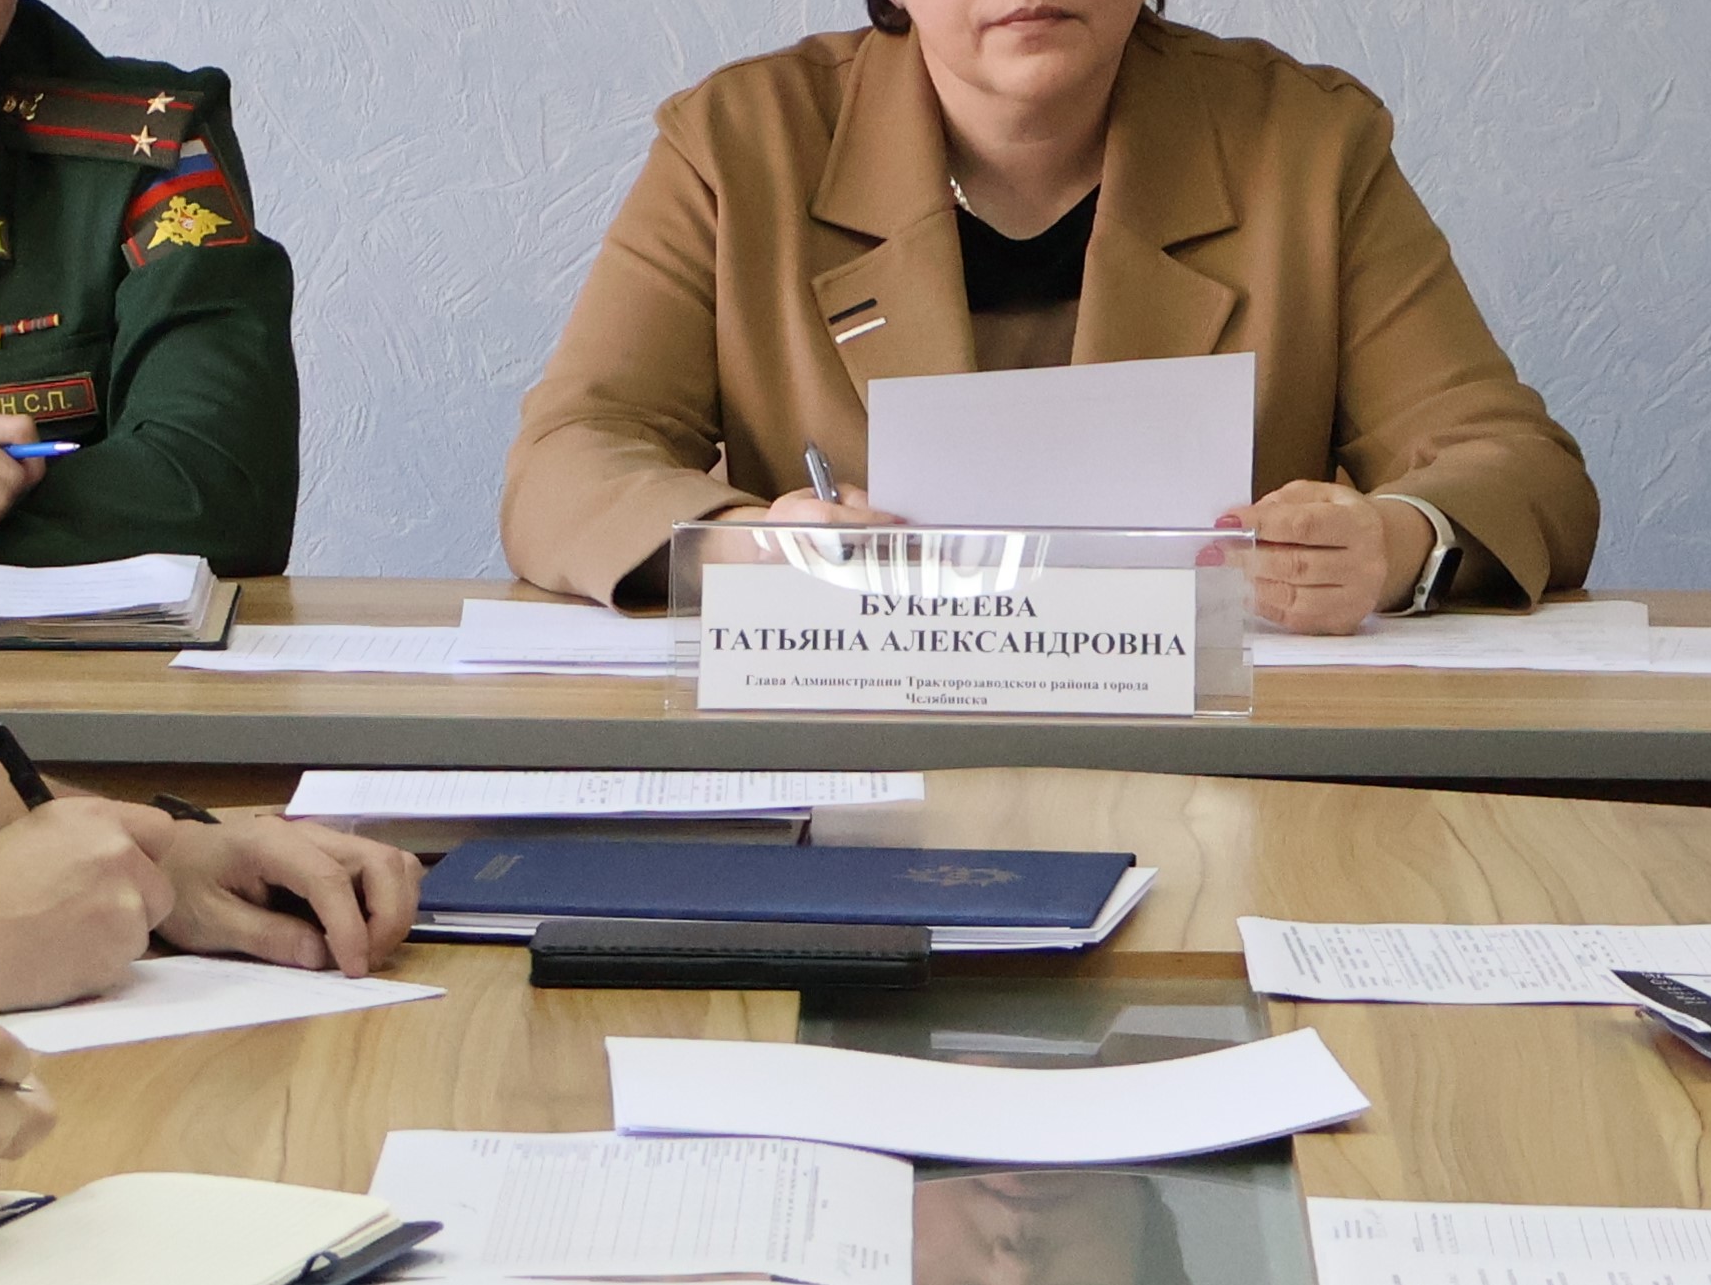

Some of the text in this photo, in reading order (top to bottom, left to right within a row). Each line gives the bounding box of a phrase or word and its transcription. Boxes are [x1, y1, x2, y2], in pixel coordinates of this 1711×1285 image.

[859, 594, 1039, 618] БУКРЕЕВА
[708, 628, 1188, 658] ТАТЬЯНА АЛЕКСАНДРОВНА
